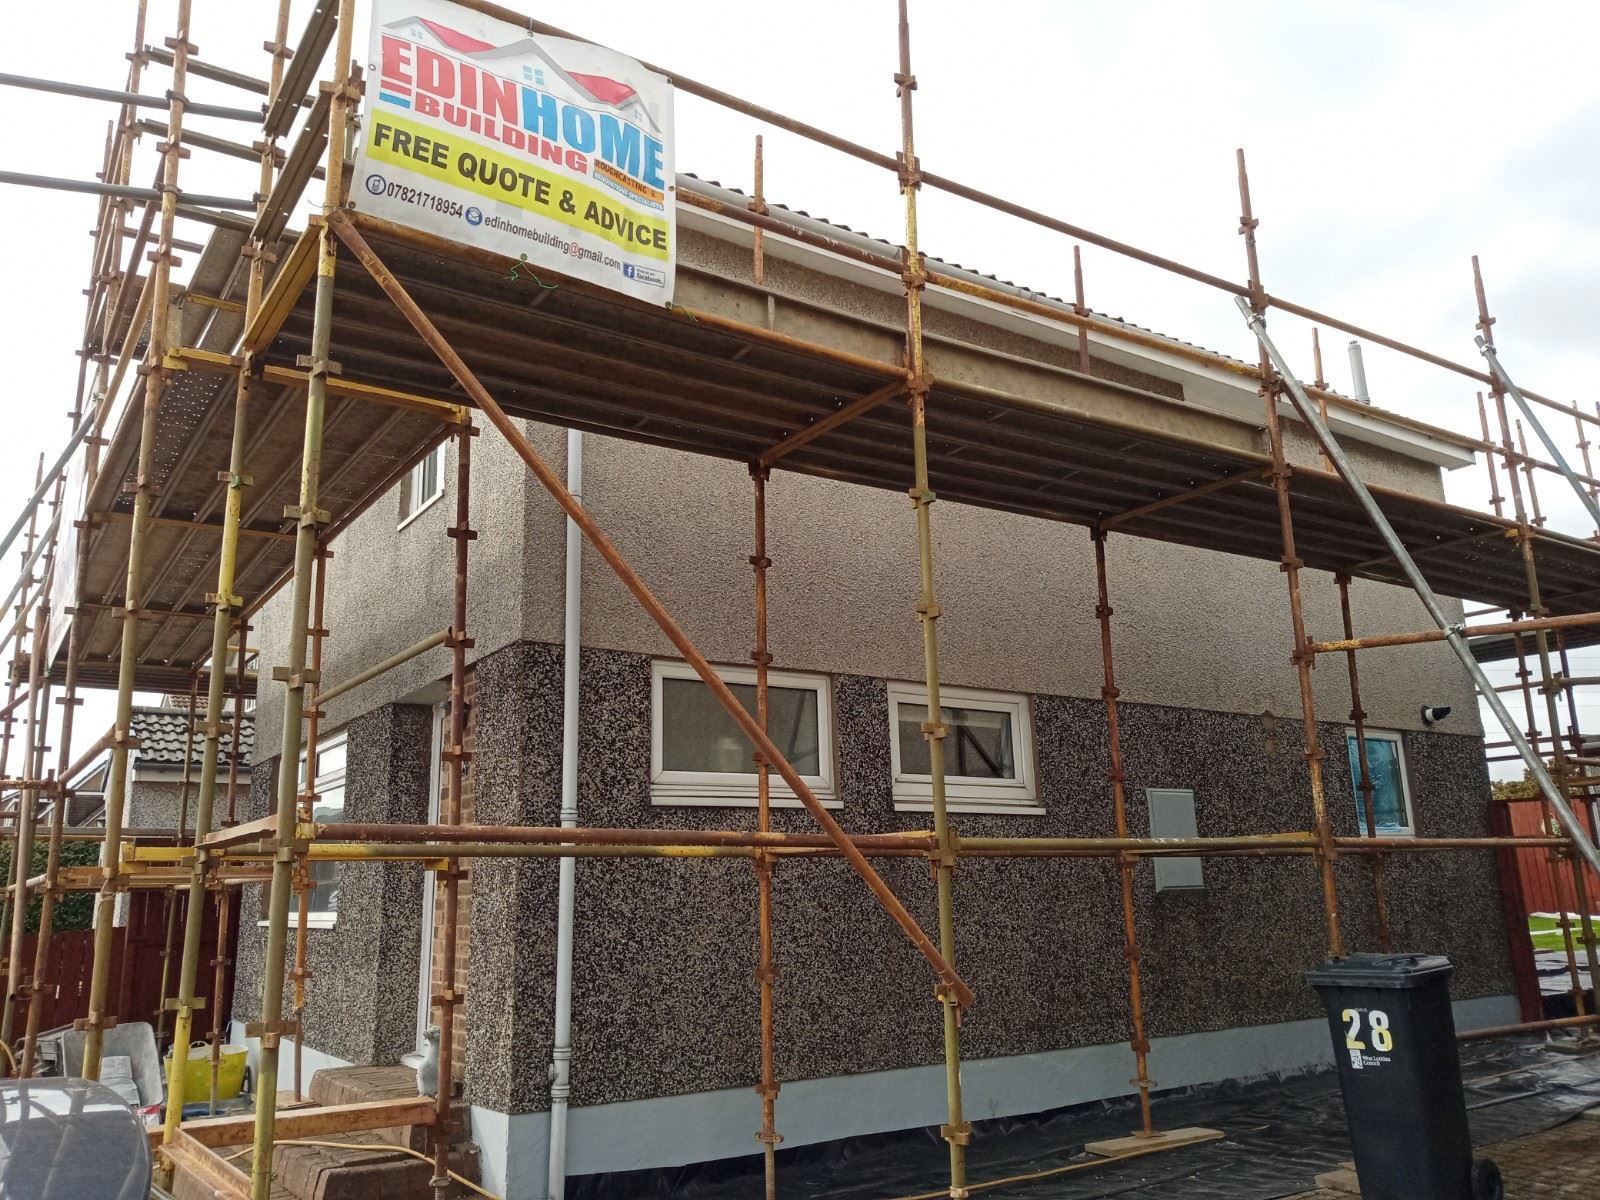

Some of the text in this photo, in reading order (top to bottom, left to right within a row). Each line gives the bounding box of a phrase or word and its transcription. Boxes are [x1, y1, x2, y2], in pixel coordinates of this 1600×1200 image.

[381, 35, 665, 191] EDINHOME
[414, 91, 588, 175] BUILDING
[374, 122, 668, 251] FREE QUOTE & ADVICE
[386, 182, 464, 219] 07821718954
[594, 159, 648, 194] ROUGHCASTING
[484, 215, 621, 271] edinhomebuilding@gmail.com
[1342, 1009, 1393, 1052] 28
